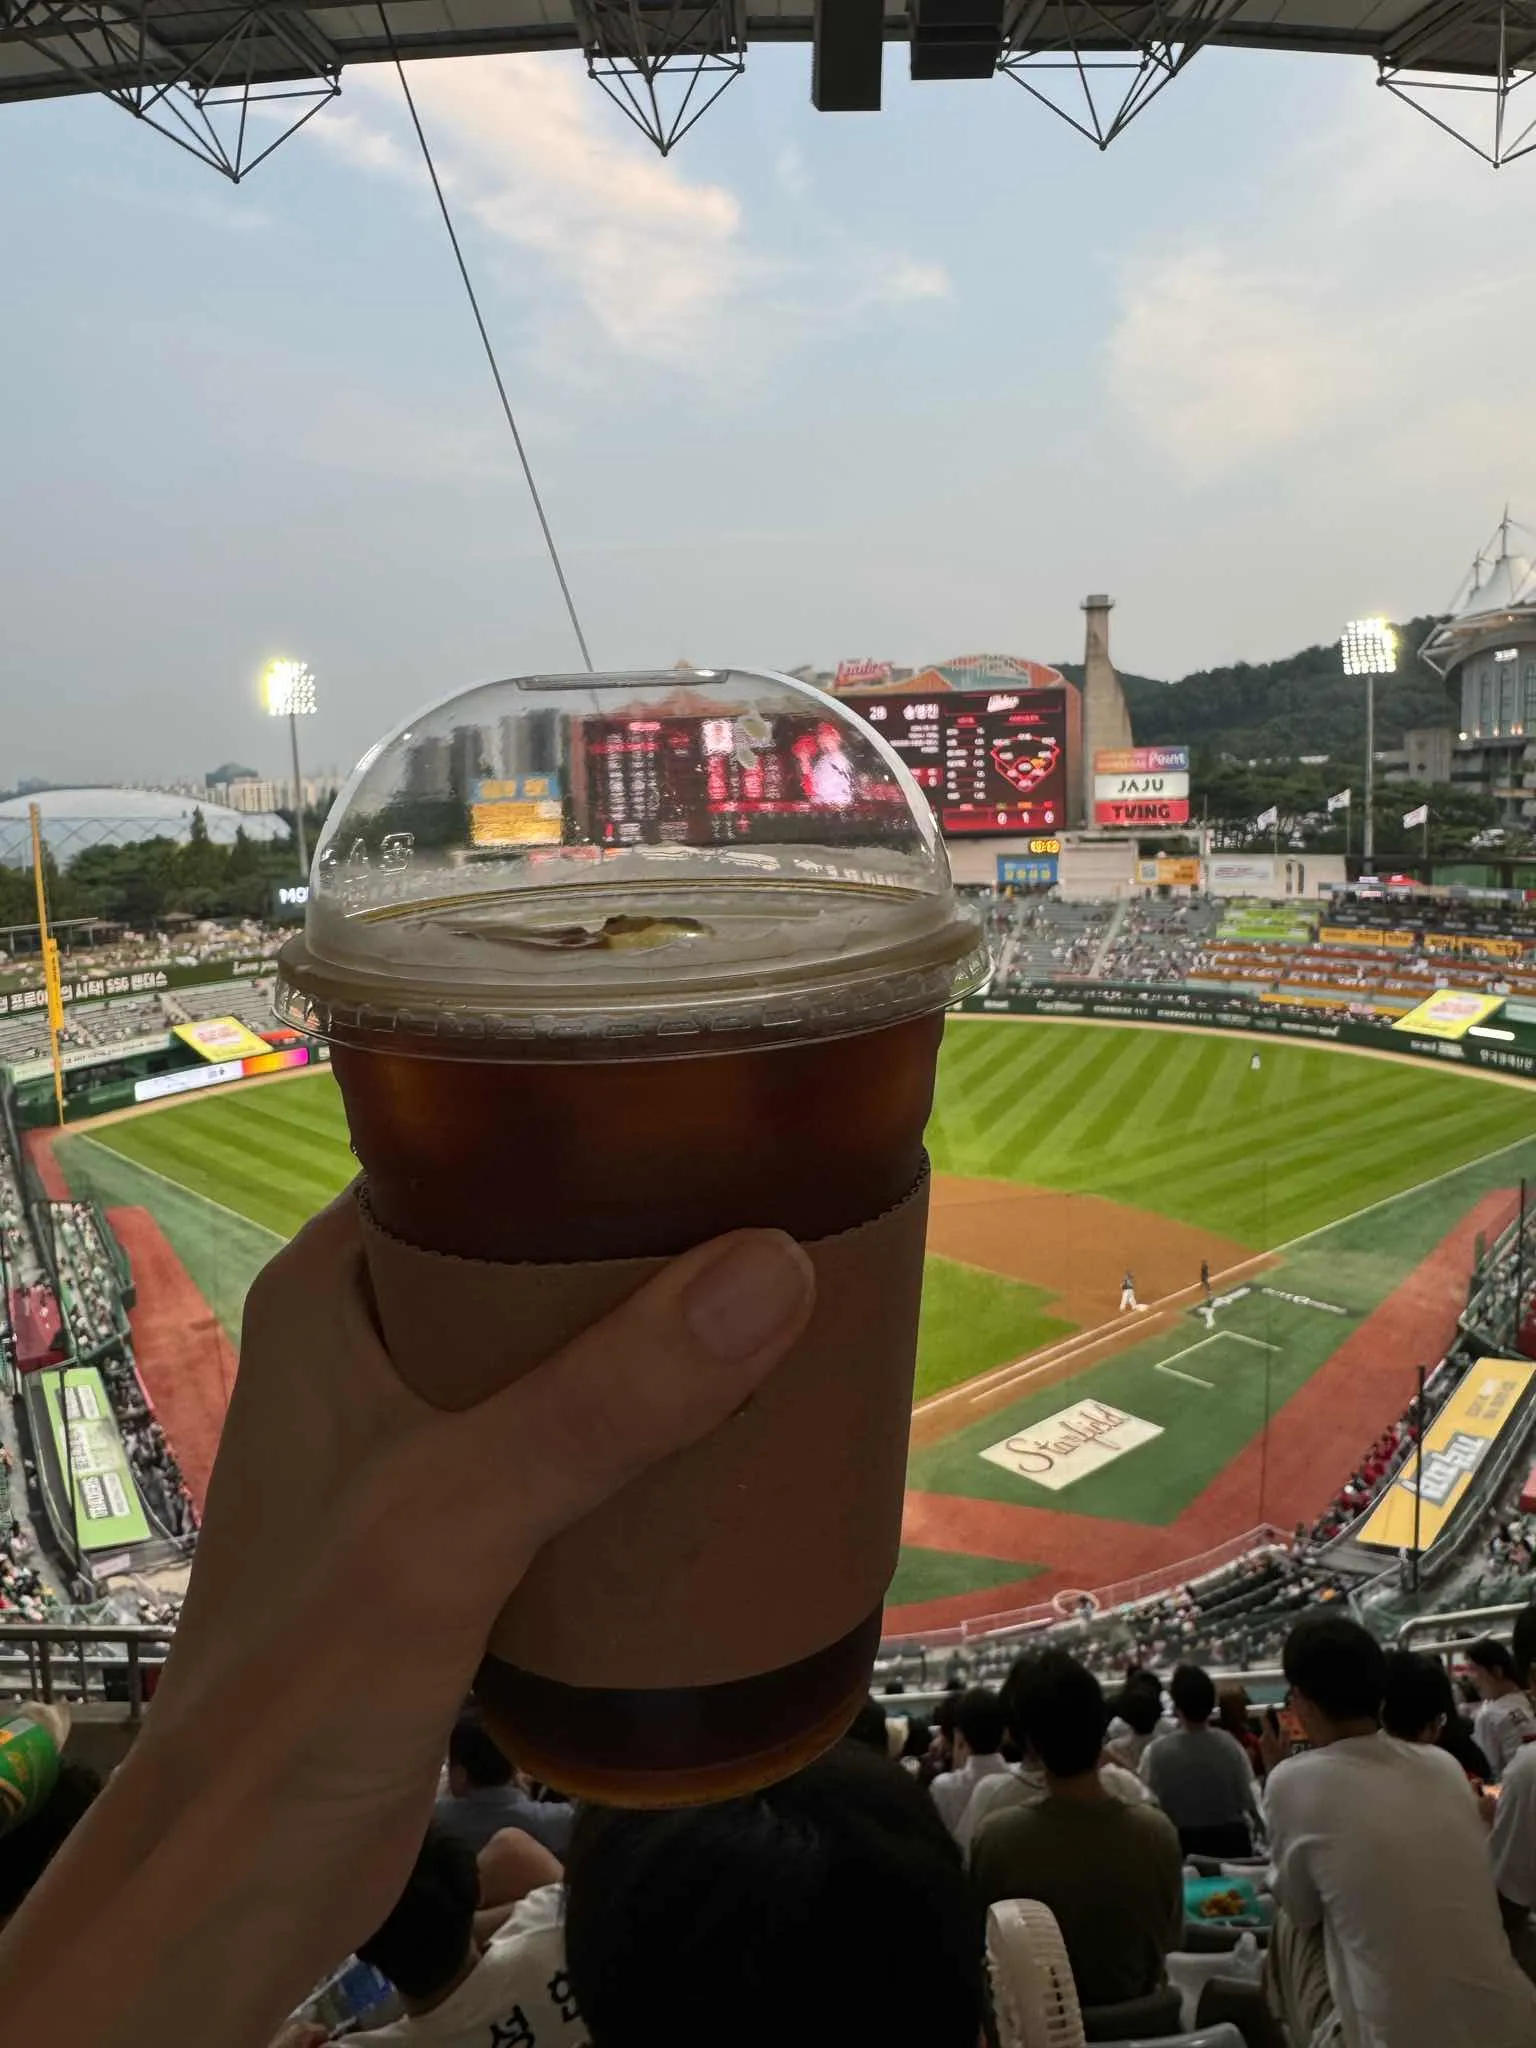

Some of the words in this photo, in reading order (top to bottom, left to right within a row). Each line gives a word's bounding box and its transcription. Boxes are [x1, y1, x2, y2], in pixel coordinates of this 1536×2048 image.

[1117, 778, 1164, 793] JAJU
[1111, 803, 1170, 819] TVING
[1005, 1404, 1131, 1473] Starfield
